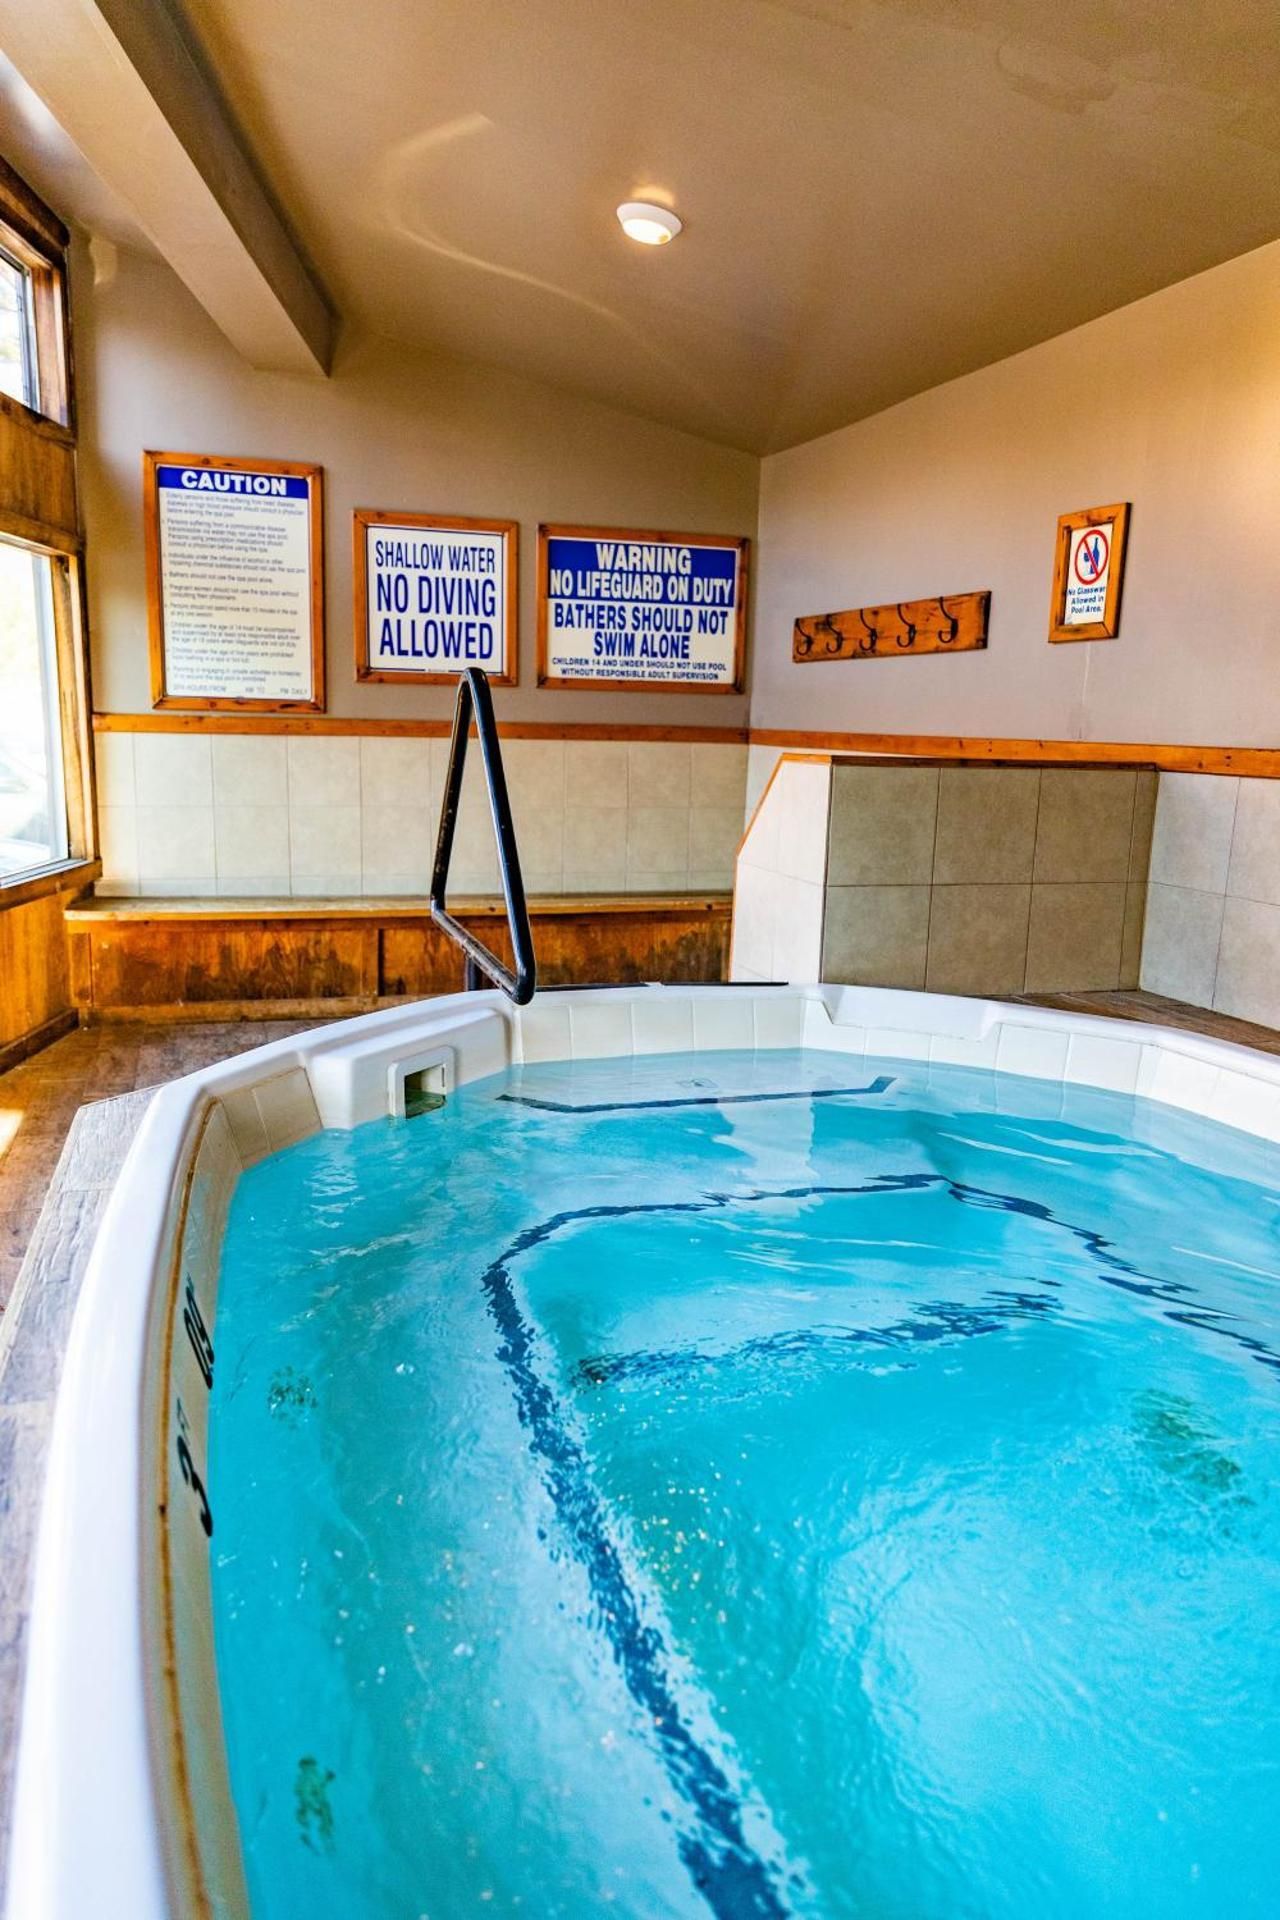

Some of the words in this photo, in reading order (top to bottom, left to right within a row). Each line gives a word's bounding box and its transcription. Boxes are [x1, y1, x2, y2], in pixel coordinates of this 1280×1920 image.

[181, 471, 287, 495] CAUTION
[376, 540, 445, 569] SHALLOW
[448, 547, 495, 573] WATER
[596, 543, 691, 574] WARNING
[377, 574, 409, 613] NO
[419, 577, 495, 617] DIVING
[550, 568, 572, 596] NO
[575, 570, 664, 601] LIFEGUARD
[666, 575, 689, 601] ON
[692, 577, 733, 604] DUTY
[1071, 596, 1096, 604] Allowed
[554, 603, 626, 630] BATHERS
[632, 607, 693, 632] SHOULD
[697, 611, 728, 635] NOT
[379, 618, 493, 659] ALLOWED
[594, 631, 636, 657] SWIM
[640, 634, 690, 659] ALONE
[552, 657, 590, 666] CHILDREN
[591, 659, 600, 667] 14
[602, 659, 617, 667] AND
[619, 660, 643, 668] UNDER
[646, 661, 674, 669] SHOULD
[691, 662, 706, 670] USE
[708, 663, 727, 671] POOL
[560, 669, 594, 677] WITHOUT
[596, 670, 646, 678] RESPONSIBLE
[648, 671, 672, 679] ADULT
[674, 672, 719, 680] SUPERVISION
[177, 1434, 213, 1538] 3
